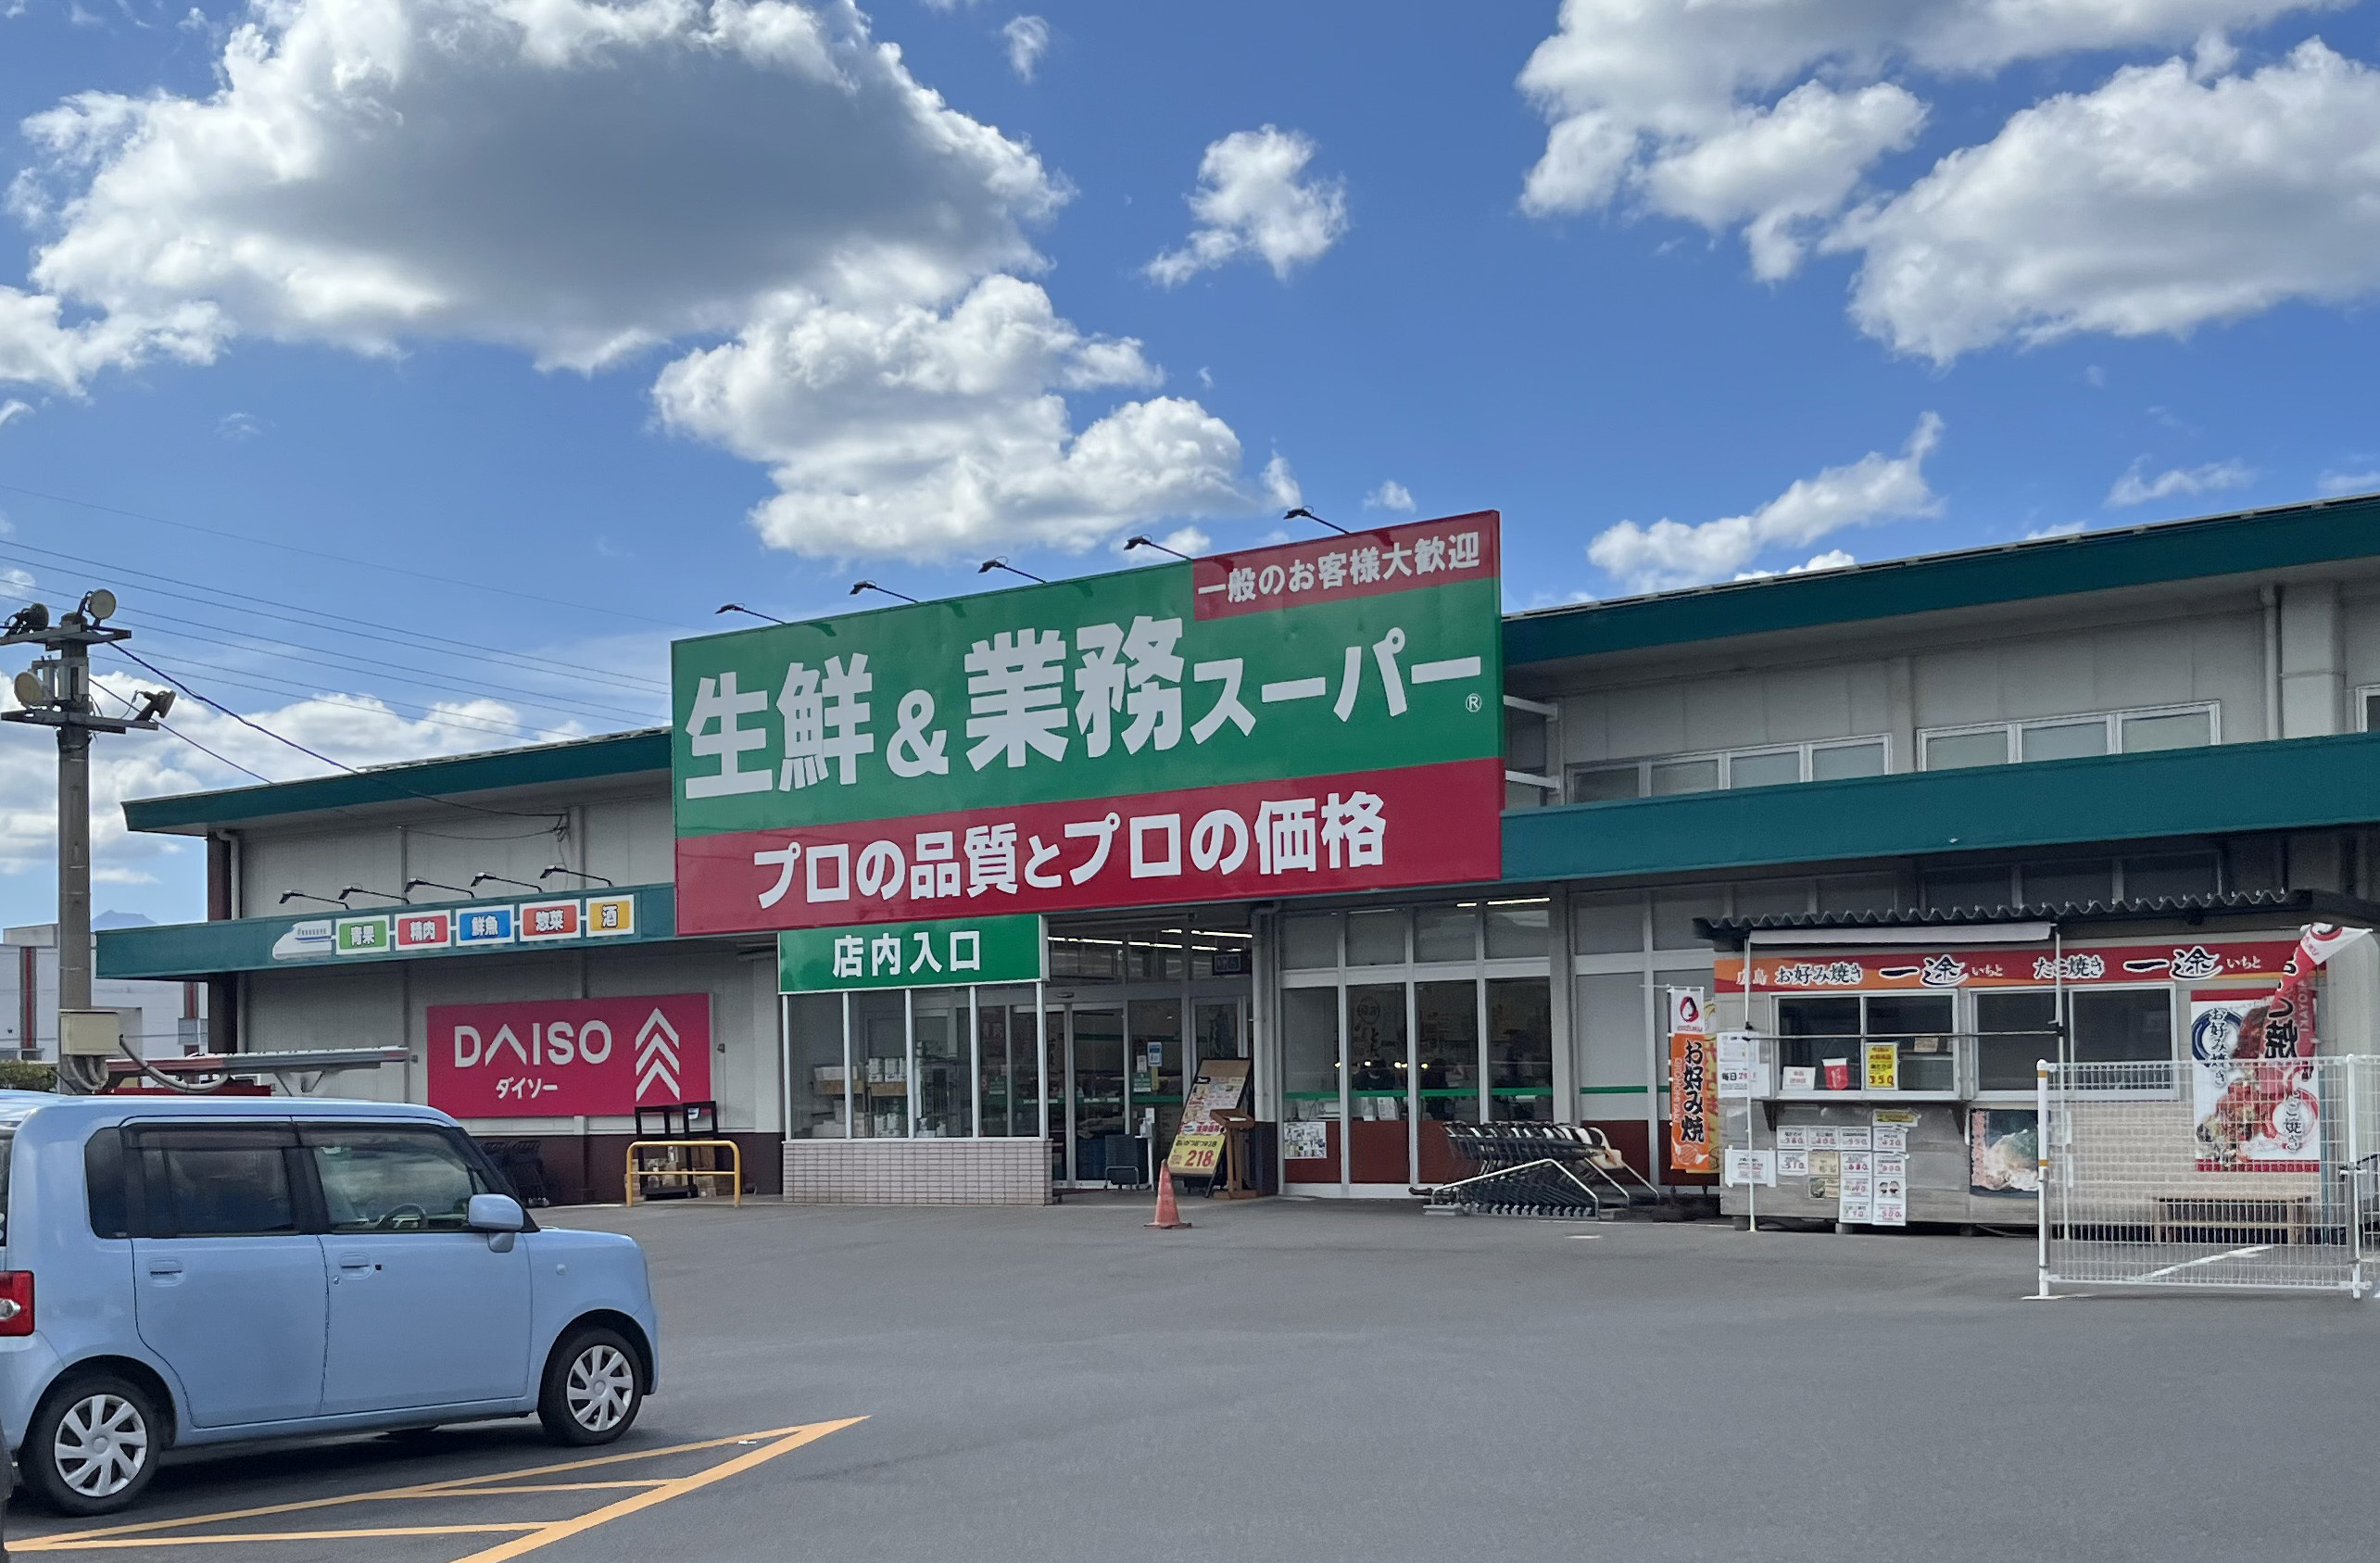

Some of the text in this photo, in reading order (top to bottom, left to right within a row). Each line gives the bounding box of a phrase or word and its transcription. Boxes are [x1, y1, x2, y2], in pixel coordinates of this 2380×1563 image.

[1198, 531, 1480, 603] 一般のお客様大歓迎
[753, 791, 1387, 909] プロの品質とプロの価格
[471, 915, 499, 937] 鮮魚
[535, 910, 564, 932] 惣菜
[602, 904, 619, 928] 酒
[349, 925, 375, 946] 青果
[409, 920, 436, 941] 精肉
[832, 930, 981, 978] 店内入口
[1775, 962, 1862, 986] お好み焼き
[1879, 954, 1969, 988] 一途
[1971, 964, 2004, 977] いちと
[2034, 954, 2105, 979] たこ焼き
[2122, 946, 2223, 979] 一途
[2226, 955, 2261, 969] いちと
[454, 1019, 612, 1068] DAISO
[496, 1076, 559, 1100] ダイソー
[1681, 1039, 1705, 1143] お好み焼
[1185, 1150, 1215, 1167] 218
